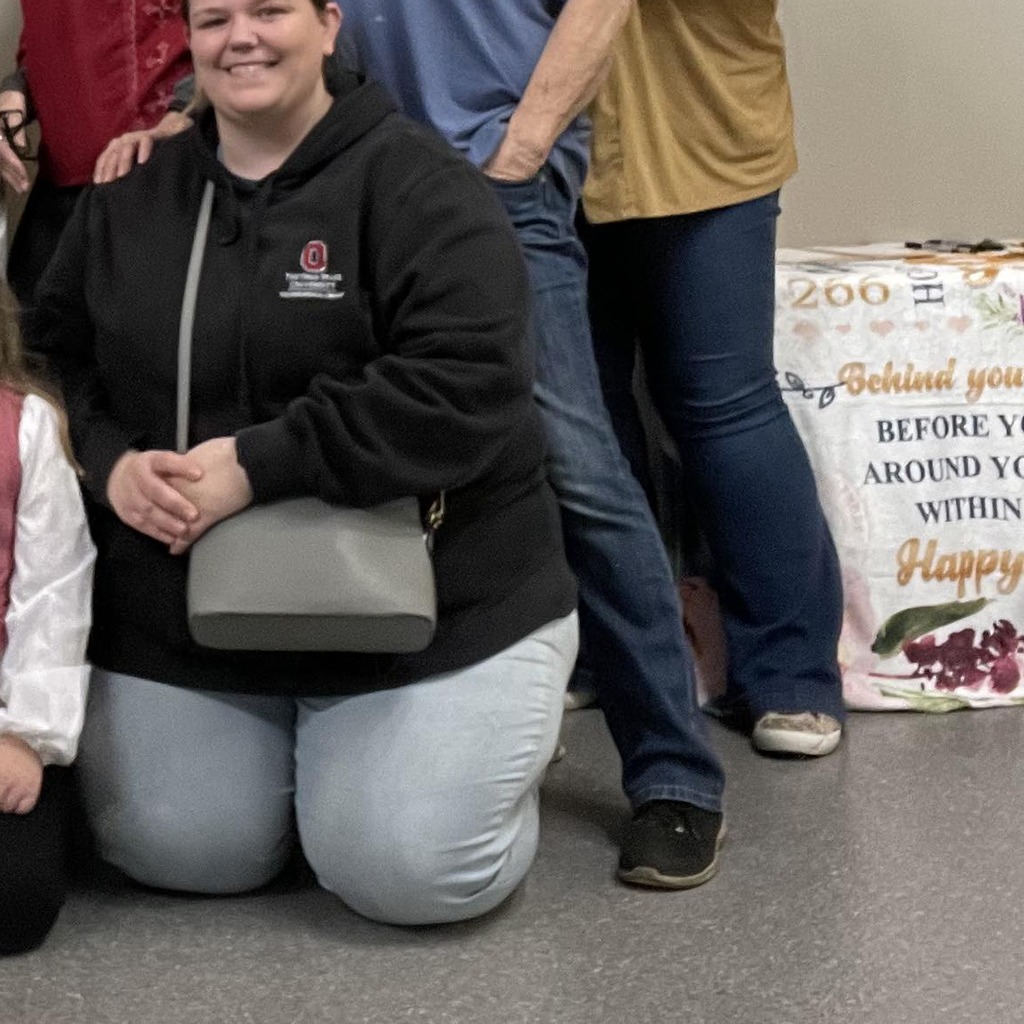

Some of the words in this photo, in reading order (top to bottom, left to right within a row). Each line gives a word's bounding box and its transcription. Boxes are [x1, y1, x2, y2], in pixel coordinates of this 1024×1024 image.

[837, 357, 958, 397] Behind
[875, 413, 990, 444] BEFORE
[863, 454, 982, 485] AROUND
[914, 495, 1022, 524] WITHIN
[895, 537, 1024, 599] Happy
